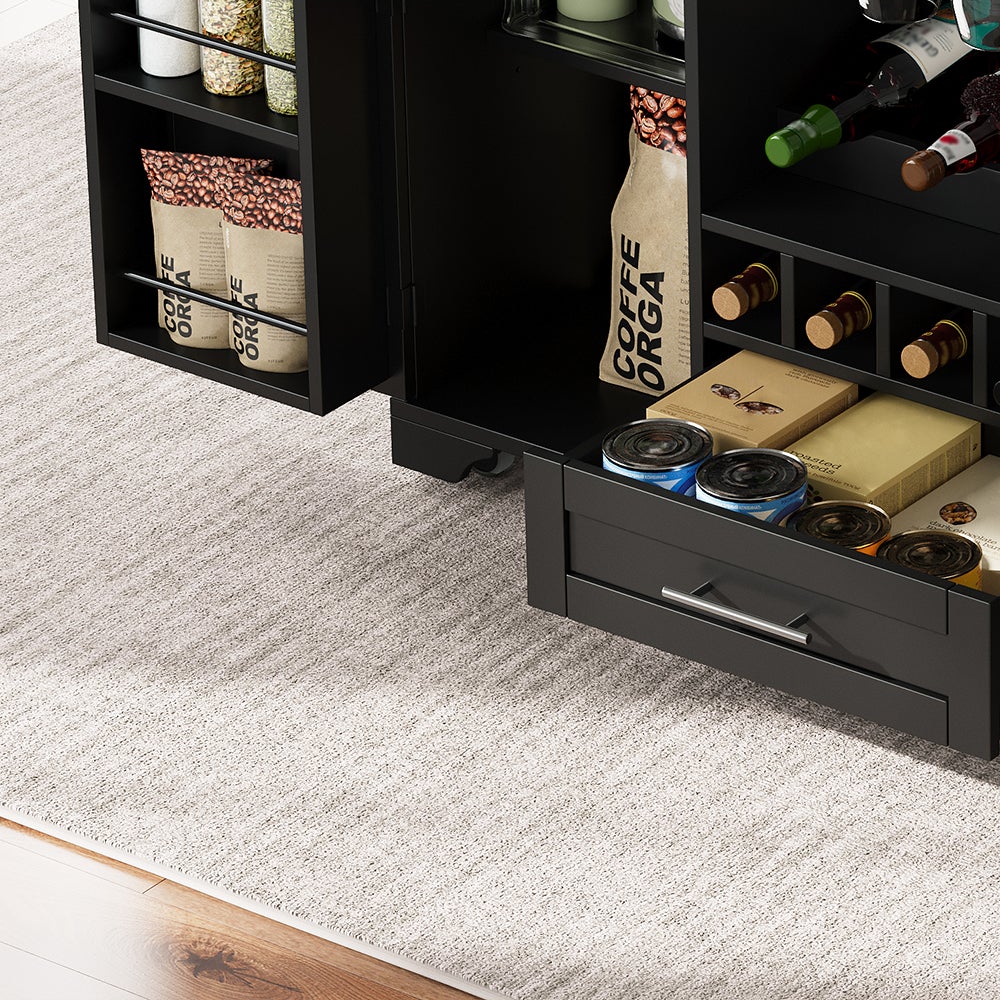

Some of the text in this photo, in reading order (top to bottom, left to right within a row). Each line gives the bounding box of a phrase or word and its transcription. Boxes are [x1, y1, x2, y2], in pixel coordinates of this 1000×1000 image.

[613, 233, 640, 380] COFFE
[637, 271, 665, 391] ORGA
[803, 462, 835, 475] eeds
